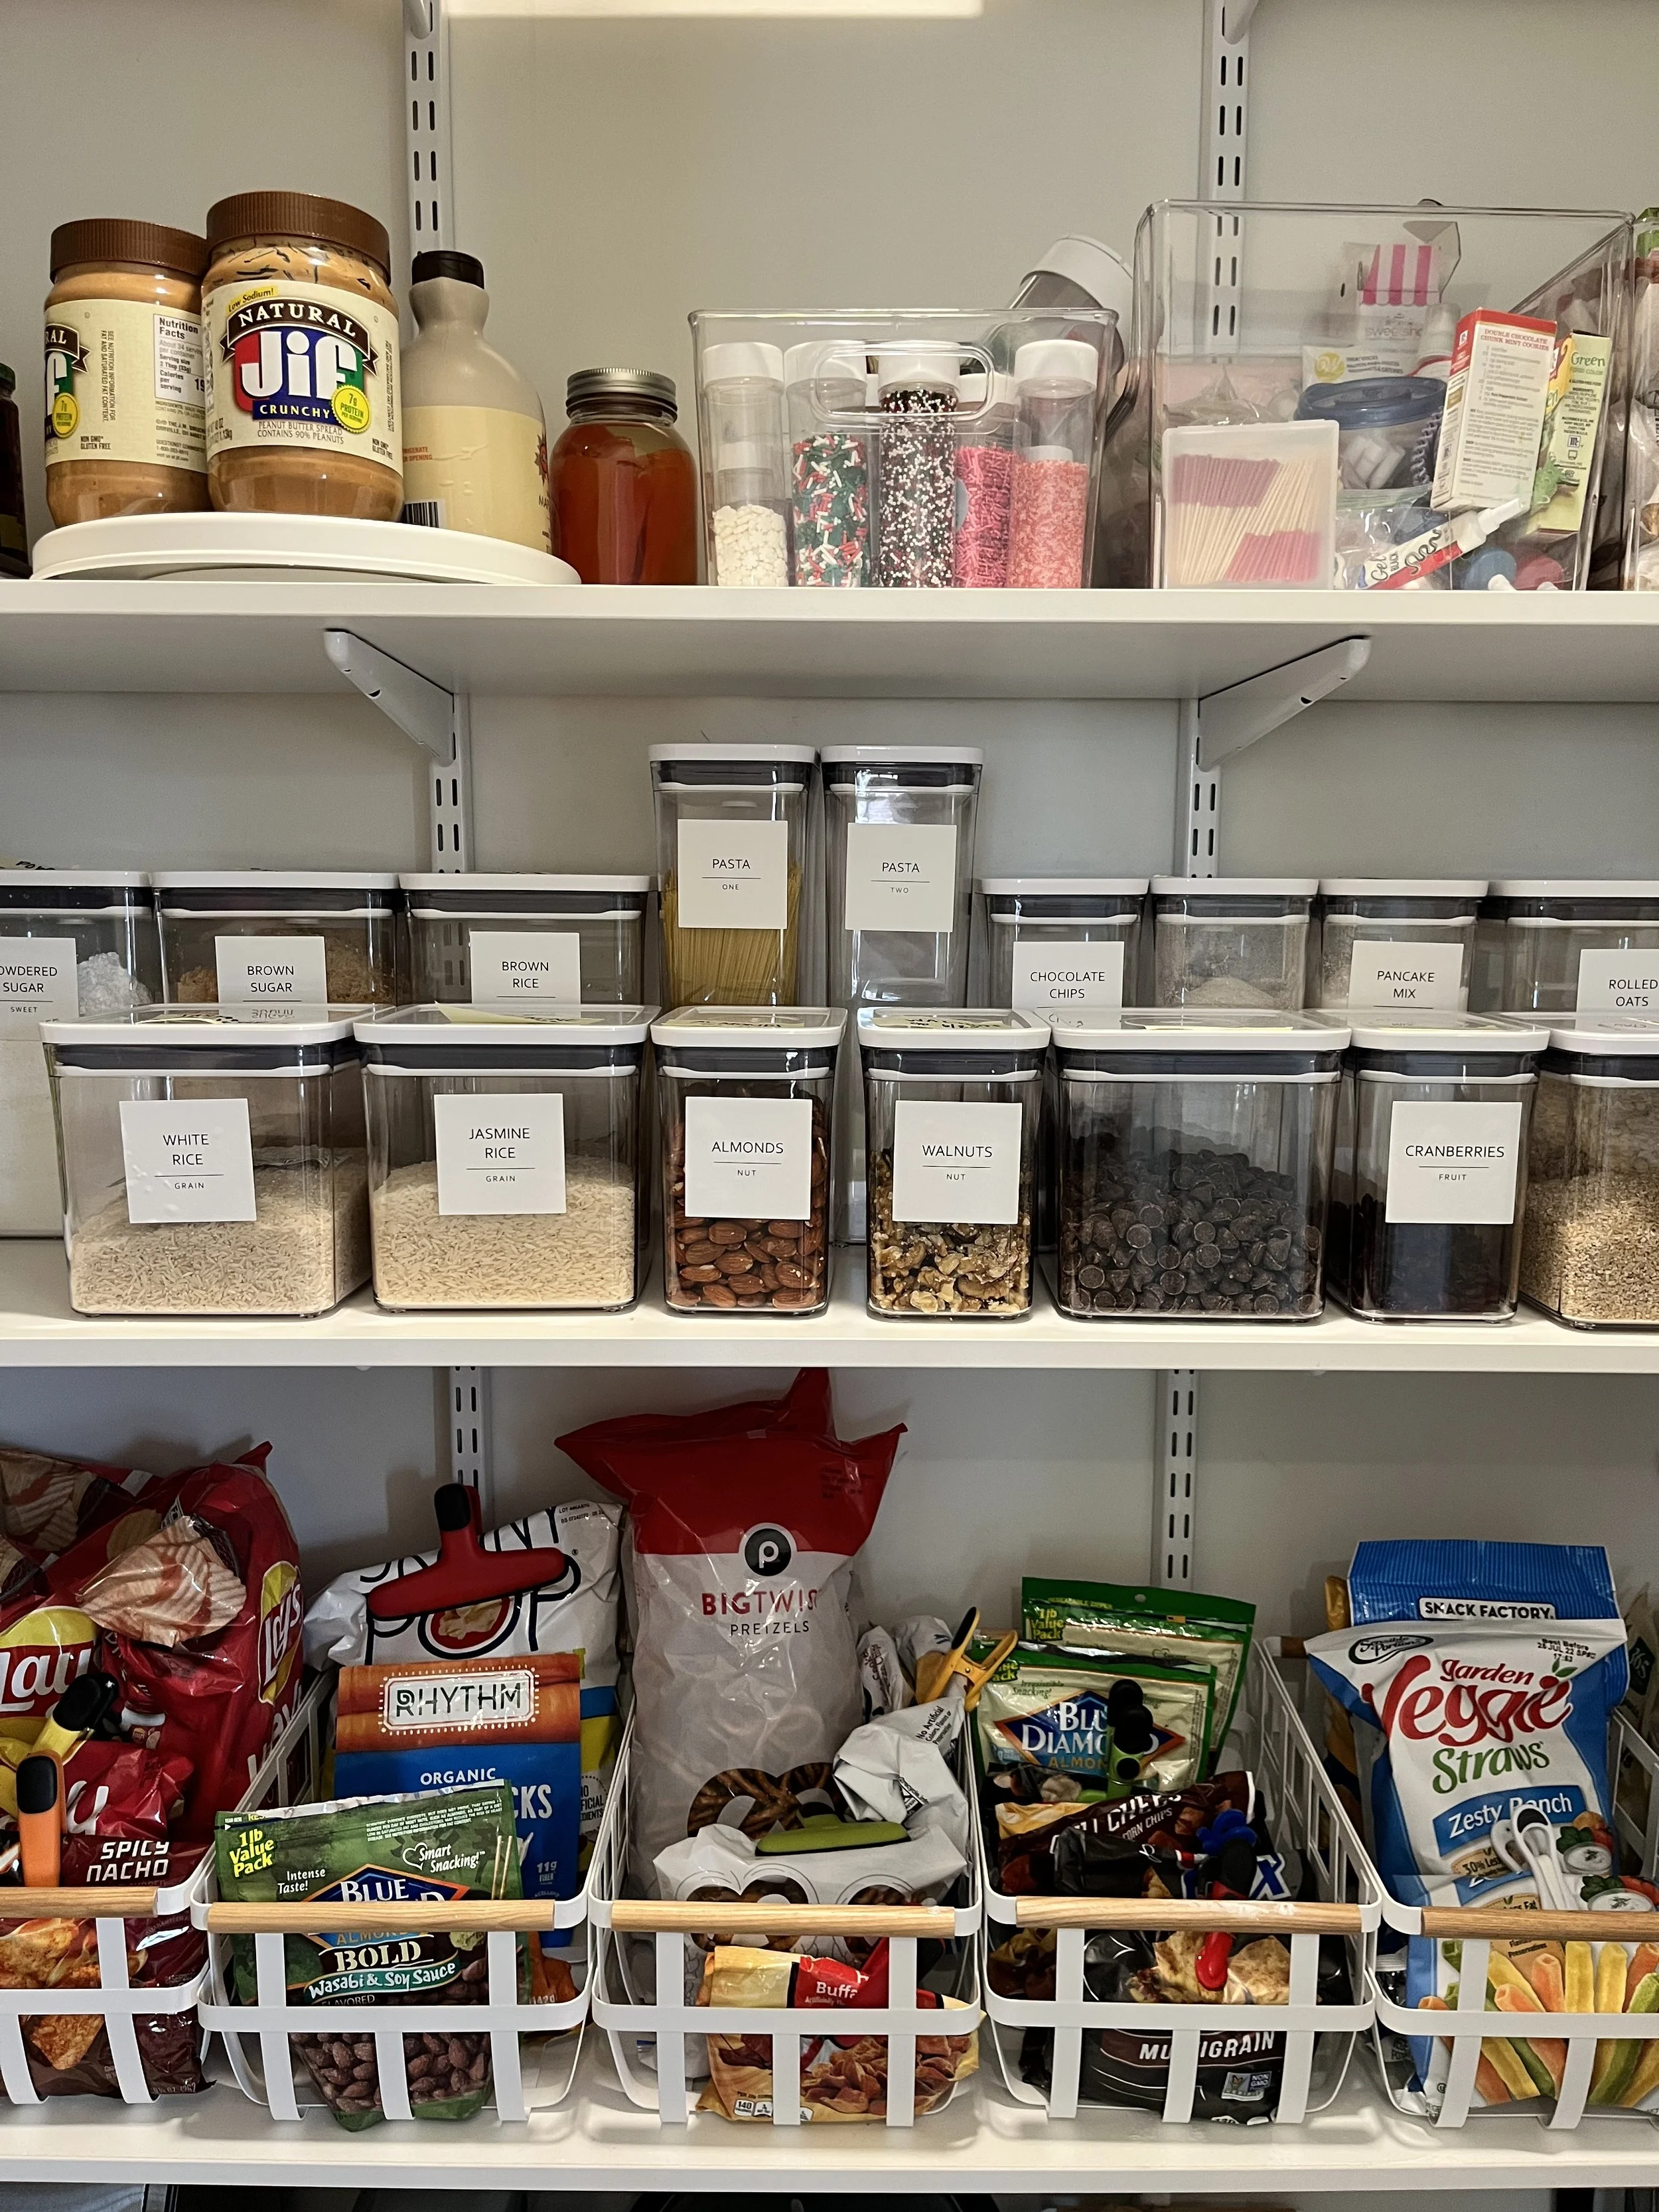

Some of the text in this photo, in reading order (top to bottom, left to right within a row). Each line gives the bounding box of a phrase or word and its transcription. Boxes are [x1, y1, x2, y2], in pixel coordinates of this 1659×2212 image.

[228, 288, 273, 312] Low Sodium!
[159, 317, 198, 334] Nutrition
[238, 303, 356, 337] NATURAL
[159, 327, 185, 339] Facts
[1484, 329, 1548, 344] DOUBLE CHOCOLATE
[1522, 342, 1549, 351] COOKIES
[159, 354, 179, 363] Serving
[241, 331, 357, 400] Jif
[1571, 352, 1605, 366] Green
[160, 370, 184, 380] Calories
[160, 384, 181, 393] serving
[349, 394, 357, 406] 7g
[259, 404, 330, 419] CRUNCHY
[340, 403, 364, 419] PROTEIN
[259, 421, 342, 435] PEANUT BUTTER SPREAD
[296, 431, 310, 439] 90%
[313, 433, 344, 445] PEANUTS
[1371, 555, 1388, 580] Gel
[712, 859, 751, 870] PASTA
[881, 862, 920, 874] PASTA
[248, 966, 294, 976] BROWN
[502, 961, 549, 972] BROWN
[1030, 970, 1106, 982] CHOCOLATE
[1377, 970, 1435, 982] PANCAKE
[3, 983, 44, 993] SUGAR
[251, 982, 293, 992] SUGAR
[512, 978, 540, 989] RICE
[1609, 979, 1659, 990] ROLLED
[1049, 988, 1085, 999] CHIPS
[1394, 988, 1416, 999] MIX
[1616, 996, 1649, 1007] OATS
[163, 1134, 210, 1146] WHITE
[469, 1128, 531, 1140] JASMINE
[484, 1147, 516, 1159] RICE
[711, 1140, 784, 1154] ALMONDS
[922, 1144, 993, 1158] WALNUTS
[1406, 1145, 1505, 1159] CRANBERRIES
[172, 1153, 203, 1165] RICE
[1425, 1601, 1477, 1617] SNACK
[730, 1621, 810, 1636] PRETZELS
[1031, 1618, 1064, 1629] Value
[1033, 1629, 1061, 1640] Pack
[1548, 1644, 1563, 1653] JUL
[1563, 1641, 1589, 1651] Before
[1440, 1659, 1534, 1686] garden
[396, 1683, 522, 1718] RHYTHM
[1361, 1655, 1574, 1747] Veggie
[916, 1706, 944, 1739] No Artificial
[1432, 1743, 1550, 1794] Straws
[420, 1767, 496, 1785] ORGANIC
[1145, 1808, 1173, 1828] CHIPS
[1448, 1805, 1502, 1838] Zesty
[101, 1840, 169, 1859] SPICY
[230, 1840, 274, 1865] Value
[419, 1844, 451, 1862] Smart
[86, 1859, 169, 1882] NACHO
[234, 1853, 273, 1878] Pack
[537, 1861, 557, 1874] 11g
[1462, 1861, 1486, 1875] 30%
[287, 1868, 326, 1881] Intense
[277, 1880, 309, 1894] Taste!
[340, 1879, 409, 1902] BLUE
[334, 1941, 421, 1972] BOLD
[309, 1962, 456, 1999] Wasabi & Soy Sauce
[1139, 2031, 1274, 2060] MUIGRAIN
